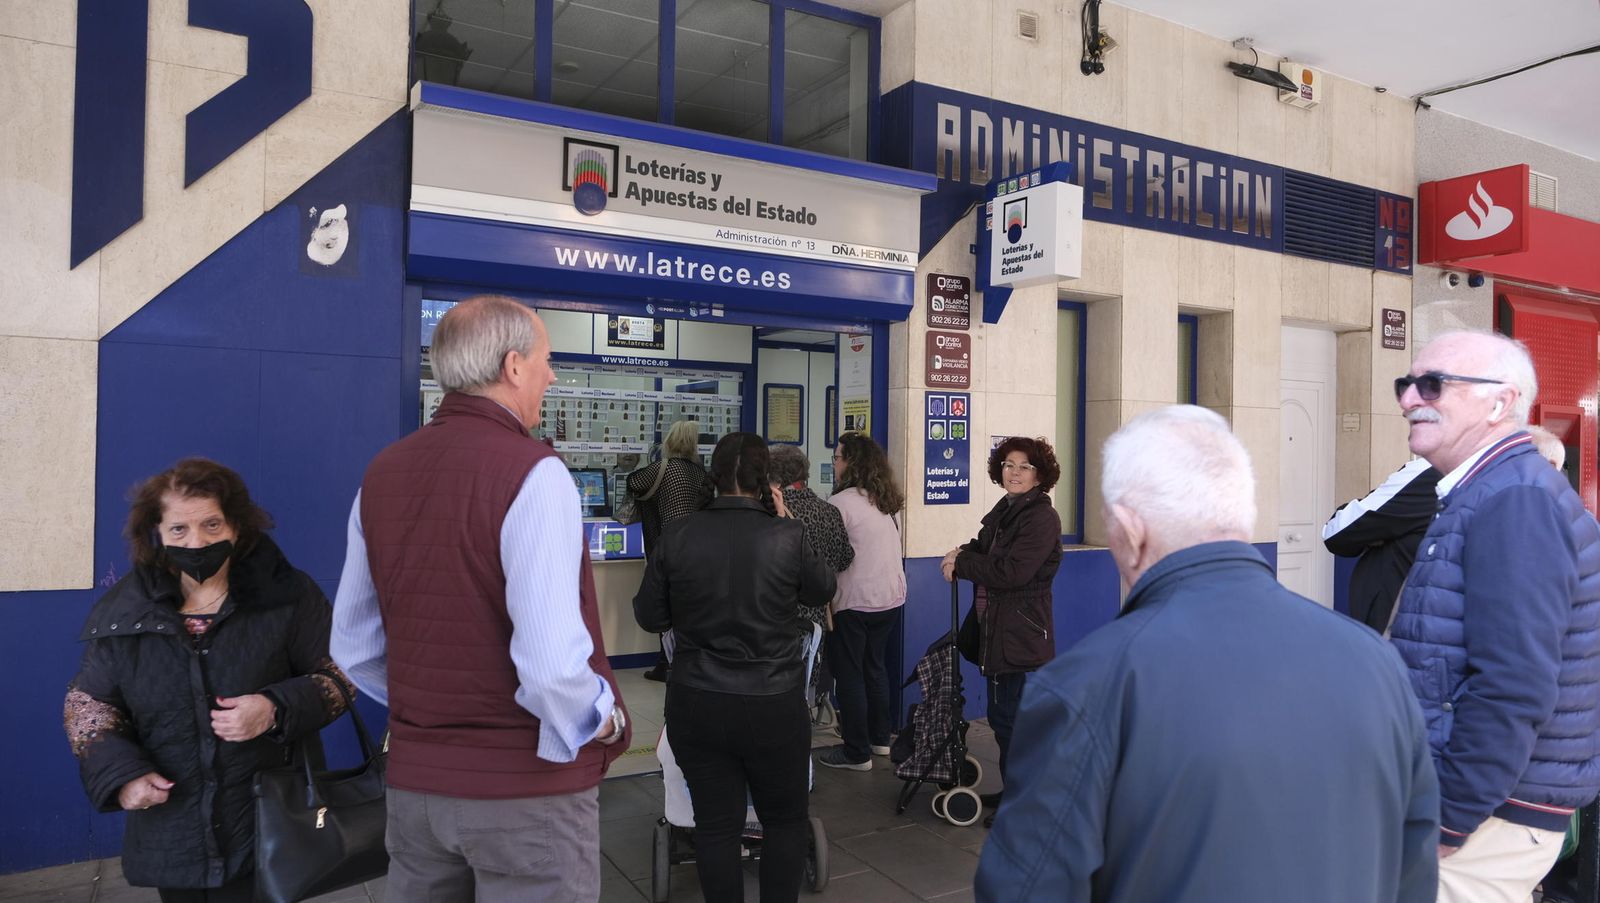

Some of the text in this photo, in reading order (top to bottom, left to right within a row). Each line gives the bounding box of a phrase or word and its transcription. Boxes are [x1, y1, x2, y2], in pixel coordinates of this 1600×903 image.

[625, 154, 723, 192] Loterías y
[625, 181, 817, 226] Apuestas del Estado
[715, 229, 815, 251] Administración nº 13
[832, 243, 909, 263] DÑA. HERMINIA
[1002, 242, 1034, 256] Loterías y
[1384, 235, 1411, 270] 13
[1002, 249, 1044, 266] Apuestas del
[555, 247, 791, 290] www.latrece.es
[1001, 264, 1024, 276] Estado
[945, 298, 969, 307] ALARMA
[931, 315, 969, 326] 902 26 22 22
[608, 338, 664, 349] www.latrece.es
[602, 355, 669, 367] www.latrece.es
[930, 373, 968, 383] 902 26 22 22
[927, 467, 959, 477] Loterías y
[927, 478, 968, 489] Apuestas del
[927, 491, 949, 500] Estado
